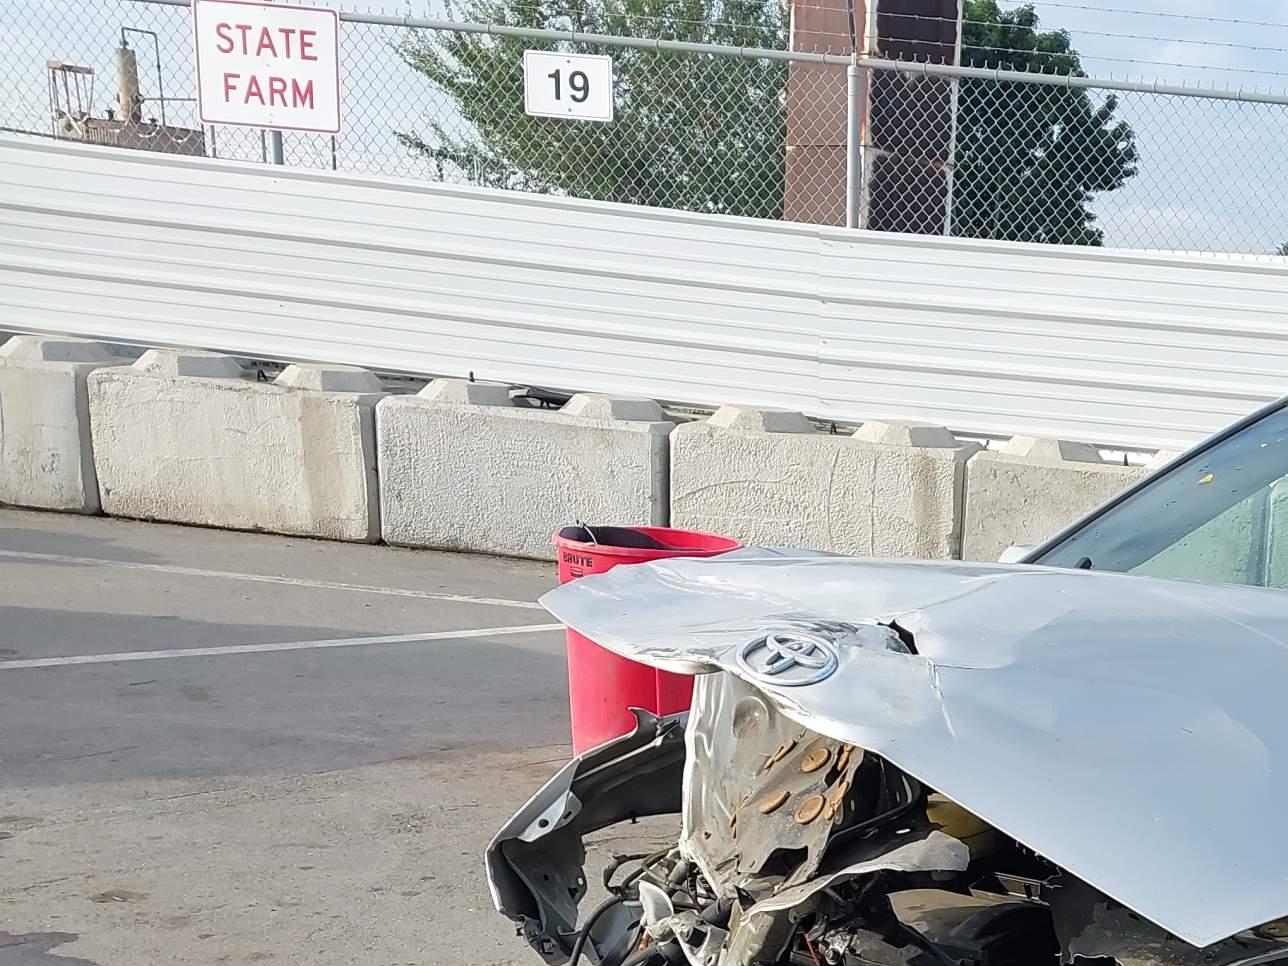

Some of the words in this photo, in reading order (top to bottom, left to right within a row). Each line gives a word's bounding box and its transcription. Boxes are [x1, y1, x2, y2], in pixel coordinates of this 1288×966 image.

[216, 23, 318, 61] STATE
[224, 74, 315, 109] FARM
[548, 69, 590, 103] 19
[563, 552, 593, 567] BRUTE
